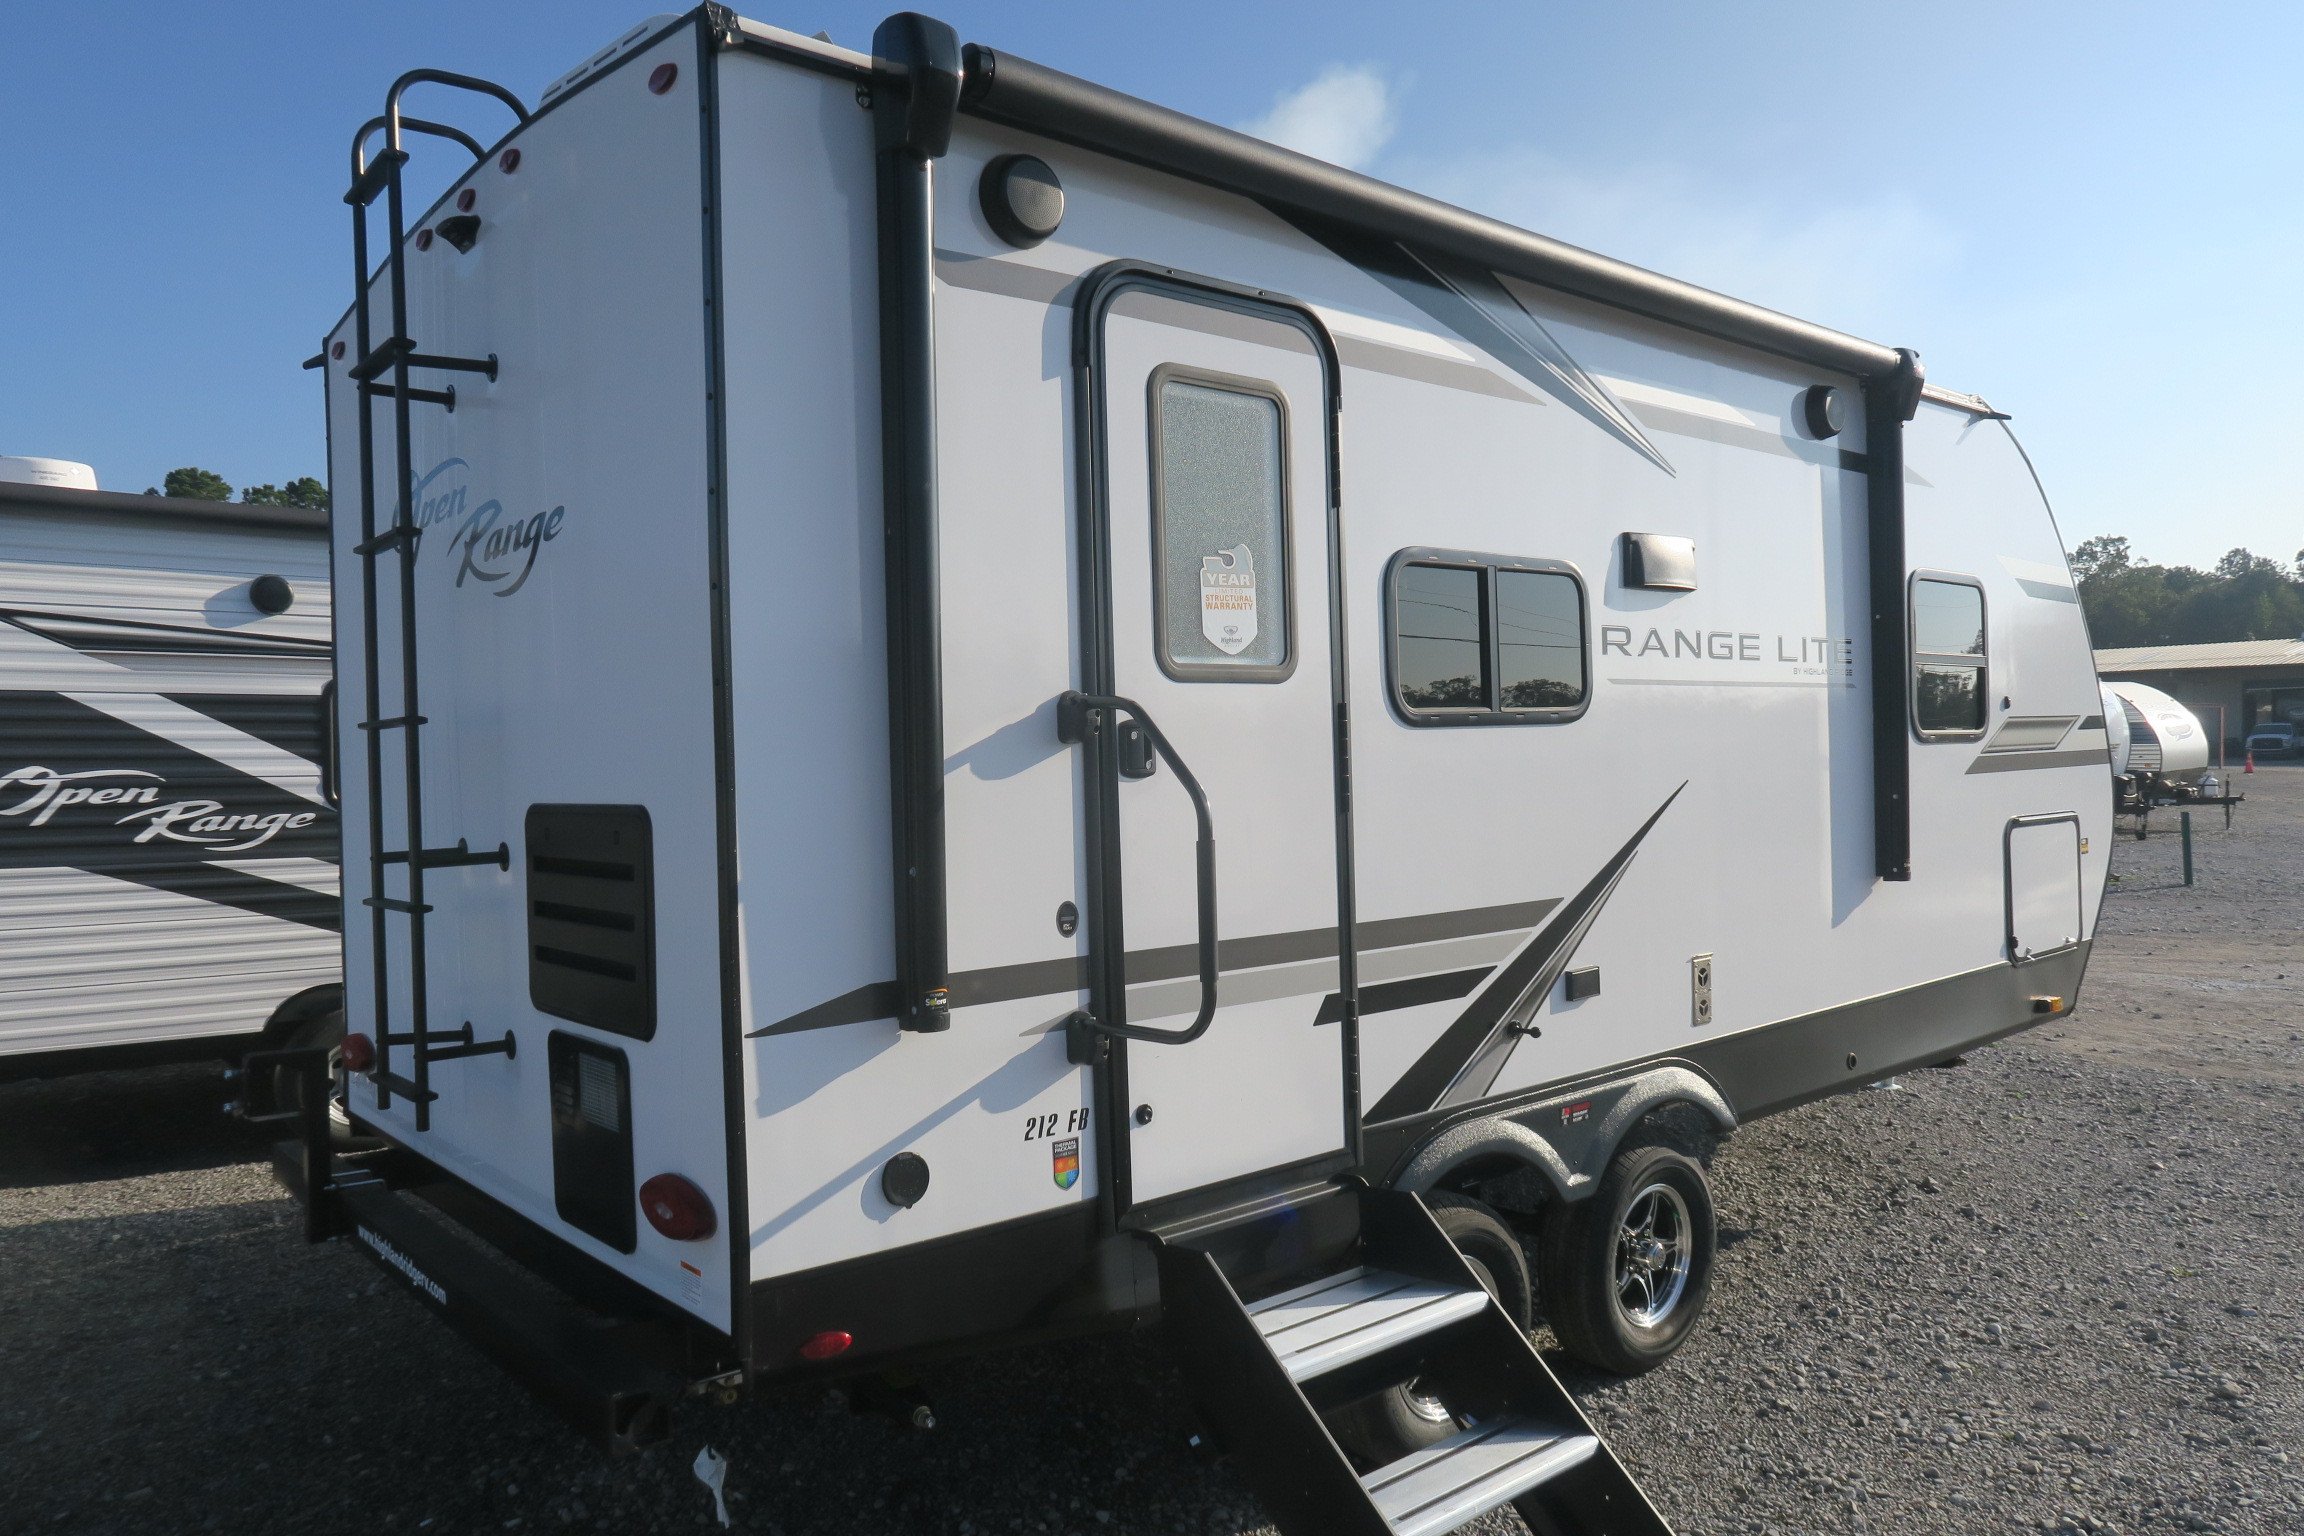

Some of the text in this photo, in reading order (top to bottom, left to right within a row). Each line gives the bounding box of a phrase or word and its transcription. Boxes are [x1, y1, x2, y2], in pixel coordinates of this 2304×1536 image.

[447, 498, 565, 598] Range
[1206, 572, 1251, 586] YEAR
[1205, 594, 1253, 602] STRUCTURAL
[1205, 602, 1254, 610] WARRANTY
[1600, 624, 1853, 664] RANGE LITE
[1793, 667, 1853, 677] BY HIGHLAND RDGE
[0, 765, 317, 852] Open Range
[1023, 1107, 1090, 1142] 212 FB
